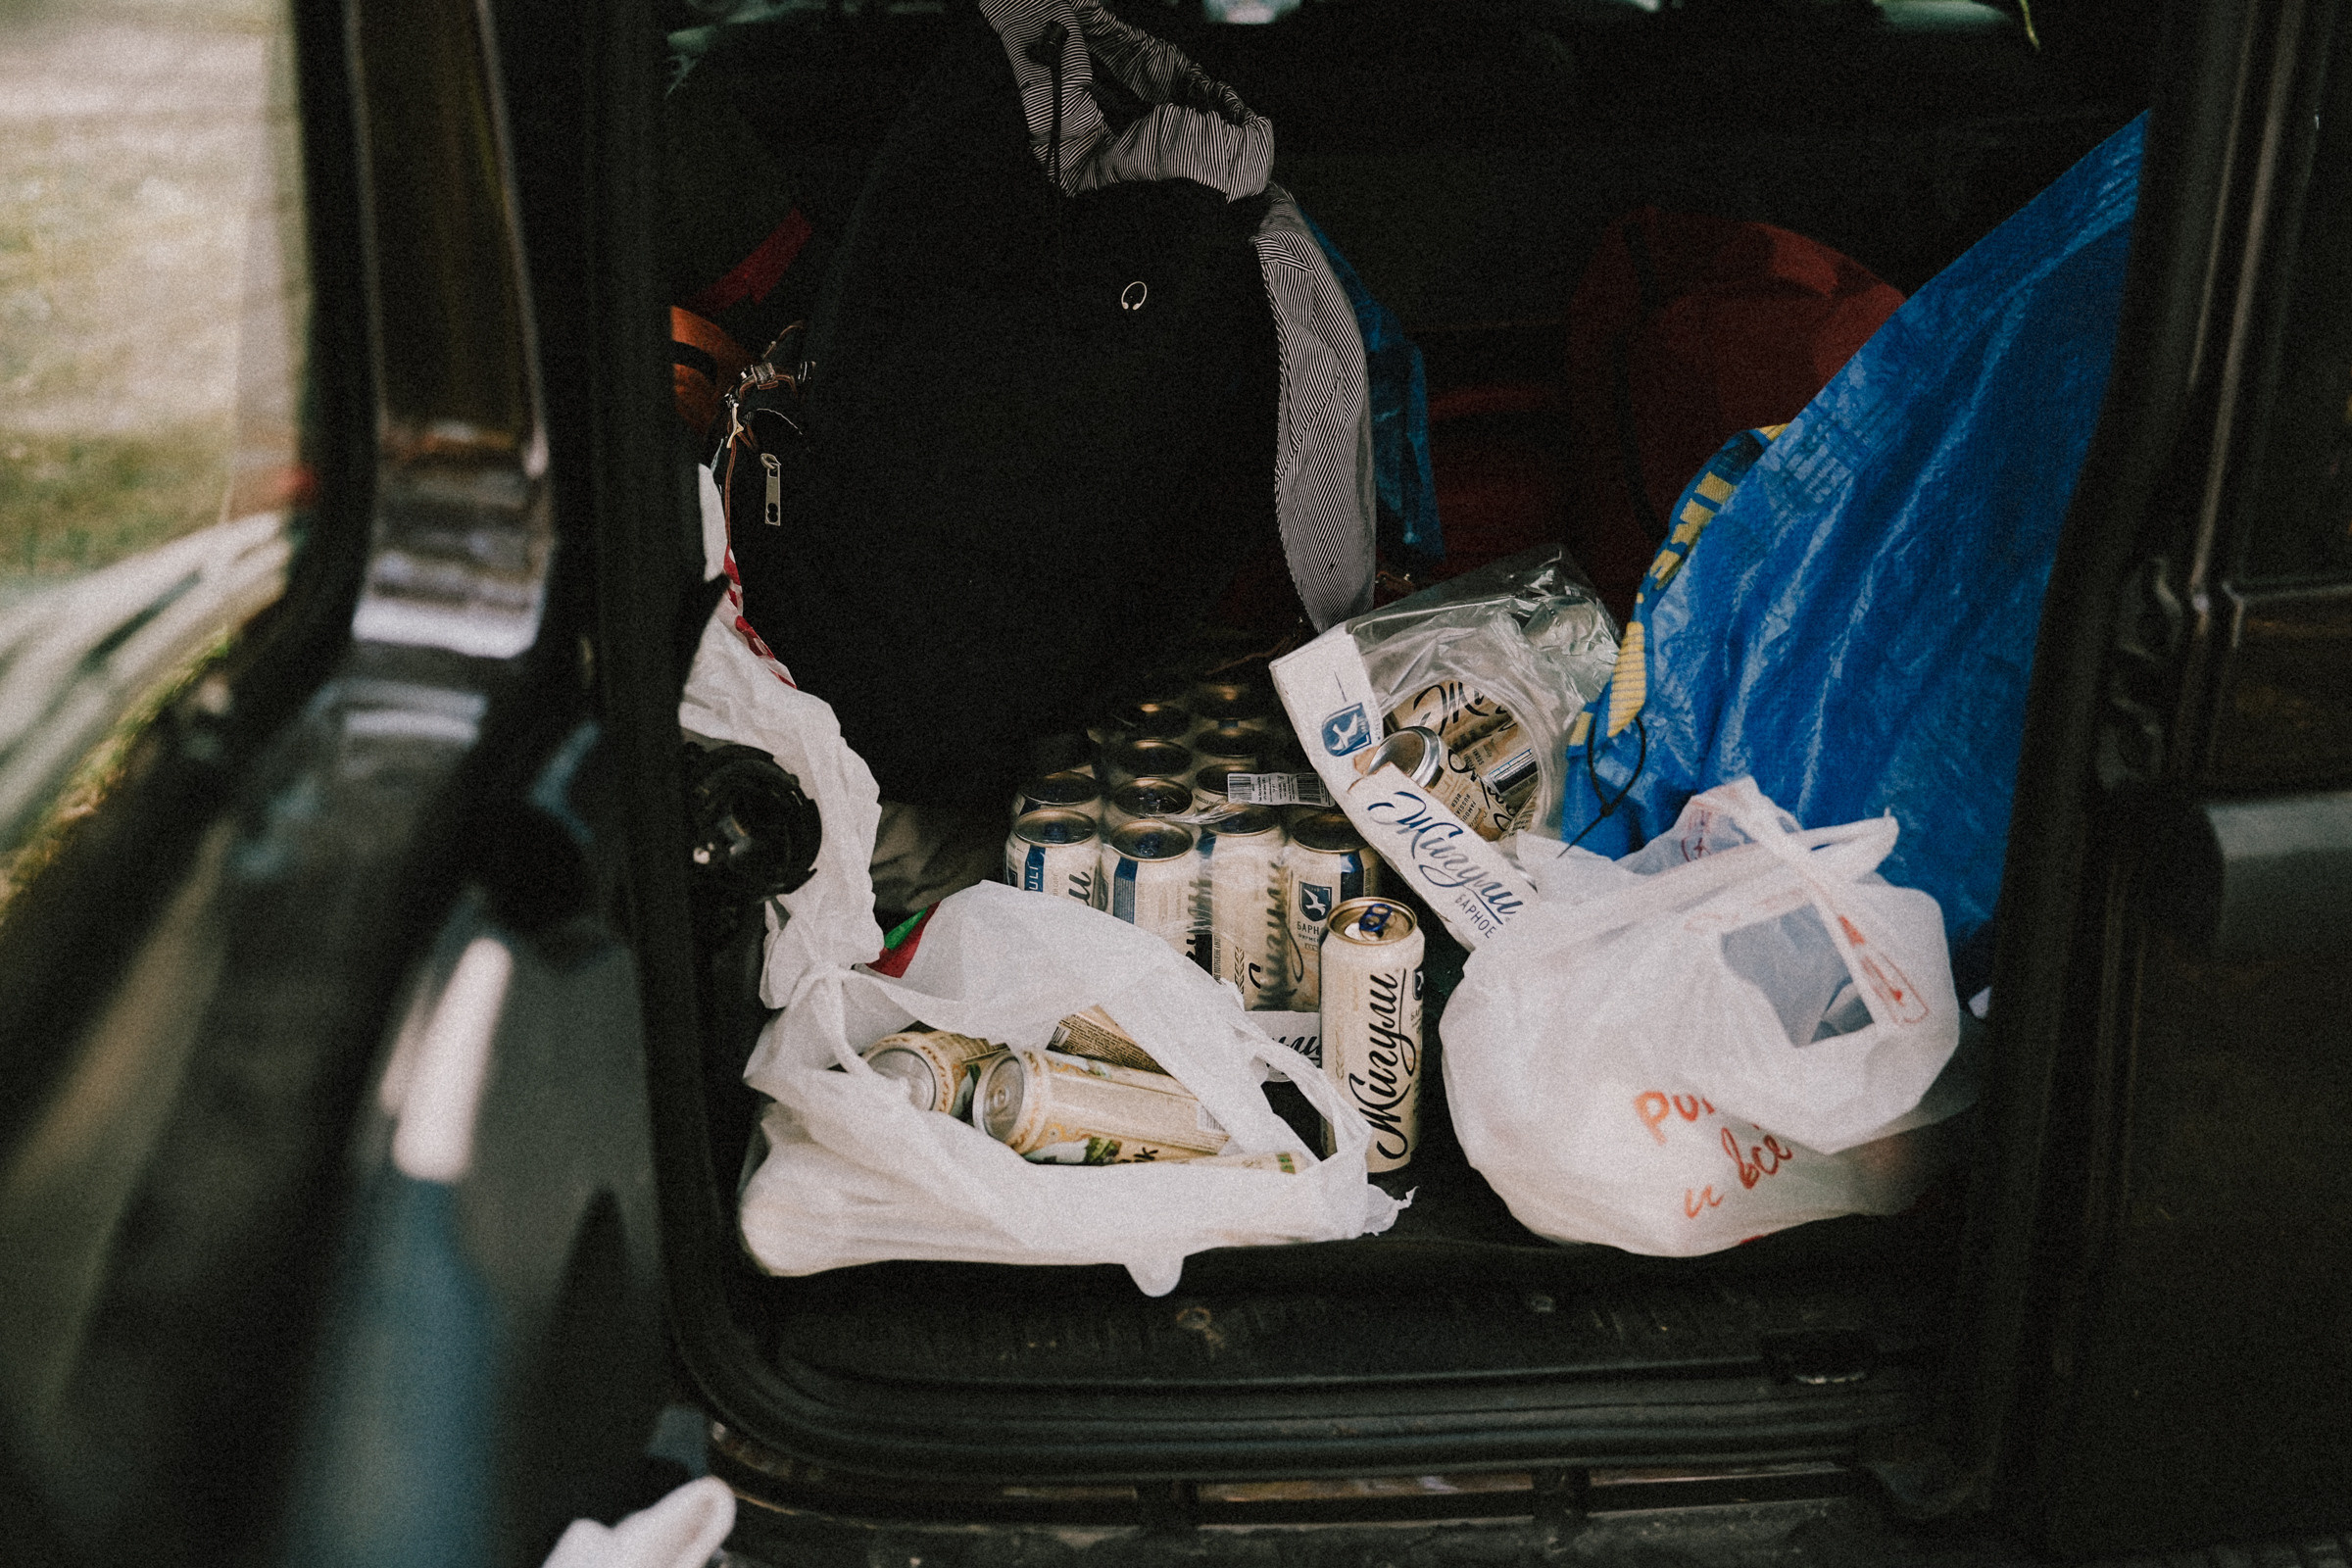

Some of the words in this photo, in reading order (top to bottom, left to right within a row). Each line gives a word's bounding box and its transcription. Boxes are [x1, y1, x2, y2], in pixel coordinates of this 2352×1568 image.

[1450, 793, 1462, 808] BEER
[1367, 791, 1524, 924] Жигули
[1297, 920, 1320, 936] БАРН
[1453, 893, 1498, 940] БАРНОЕ
[1348, 968, 1417, 1160] Жигули
